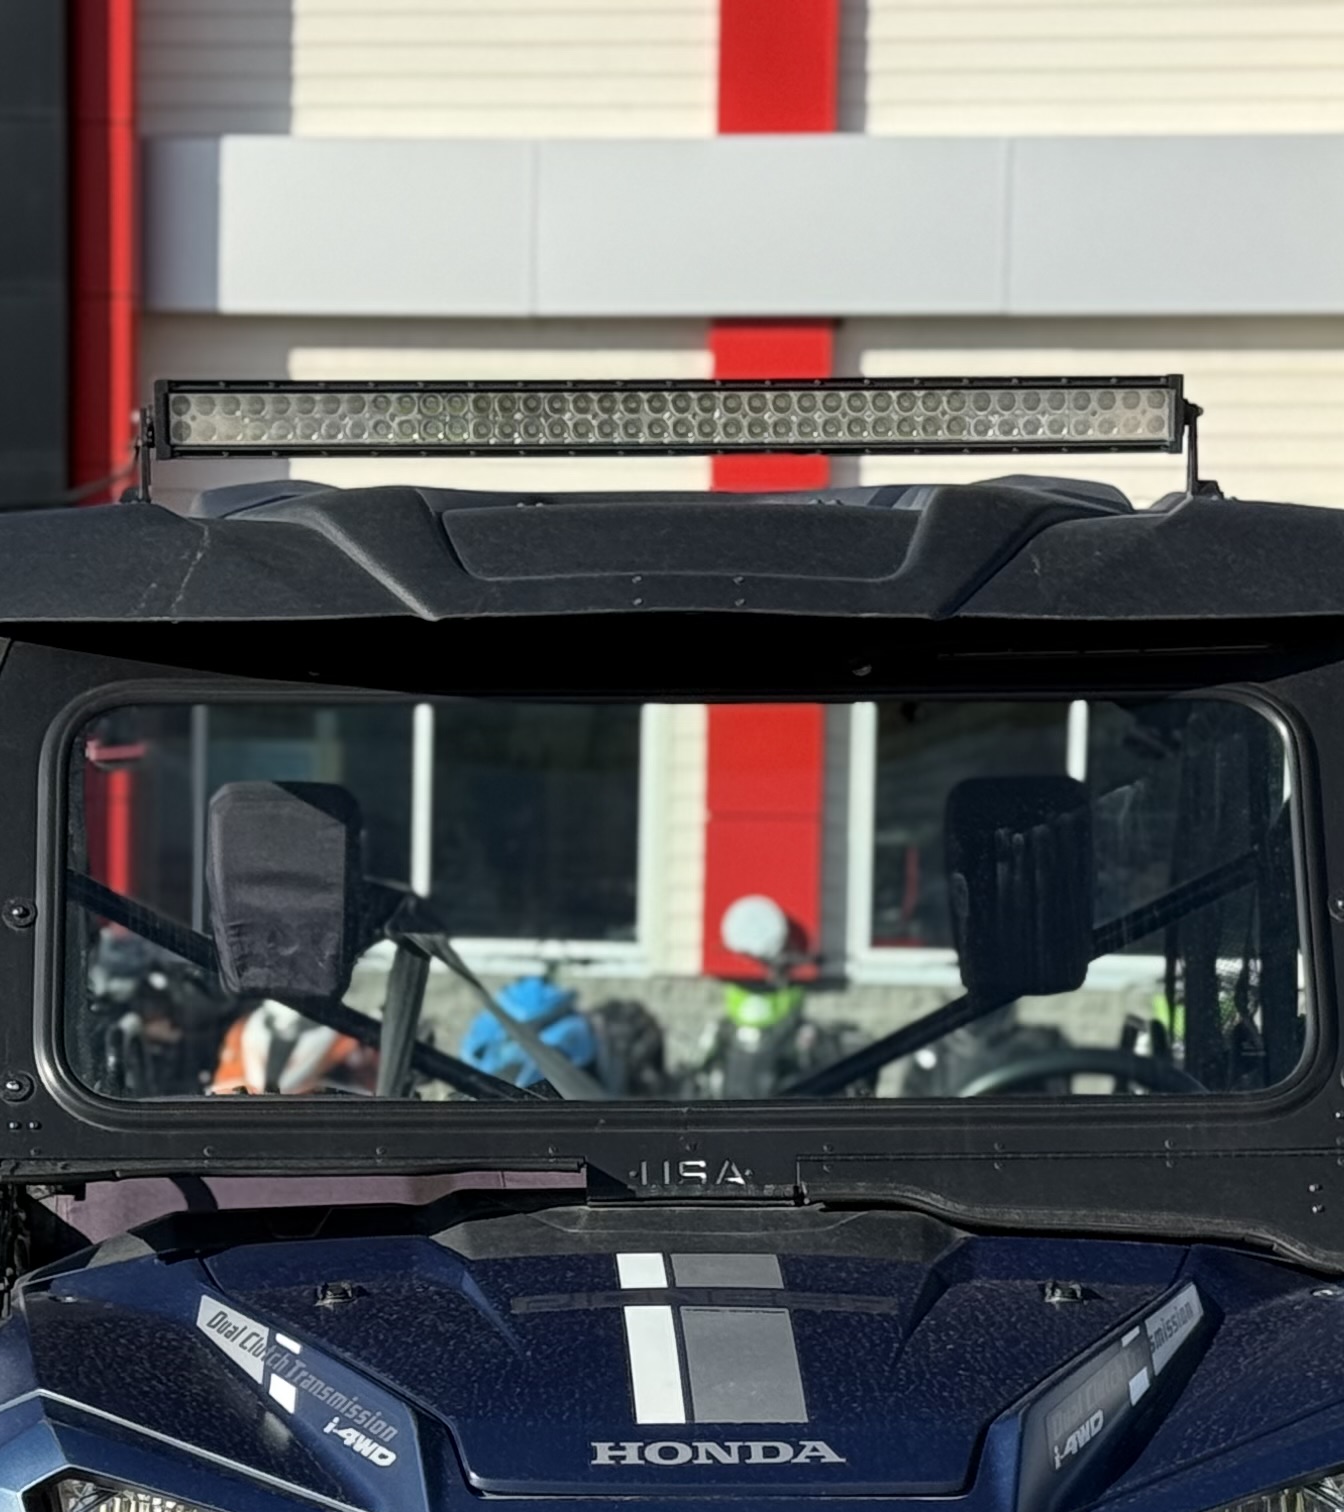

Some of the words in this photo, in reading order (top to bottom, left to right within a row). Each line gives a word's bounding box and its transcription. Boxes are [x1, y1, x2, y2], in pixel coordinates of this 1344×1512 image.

[641, 1160, 746, 1186] USA
[206, 1310, 246, 1343] Dual
[239, 1330, 288, 1379] Clutch
[284, 1358, 399, 1443] Transmission
[322, 1416, 397, 1467] i-4WD
[590, 1440, 846, 1466] HONDA
